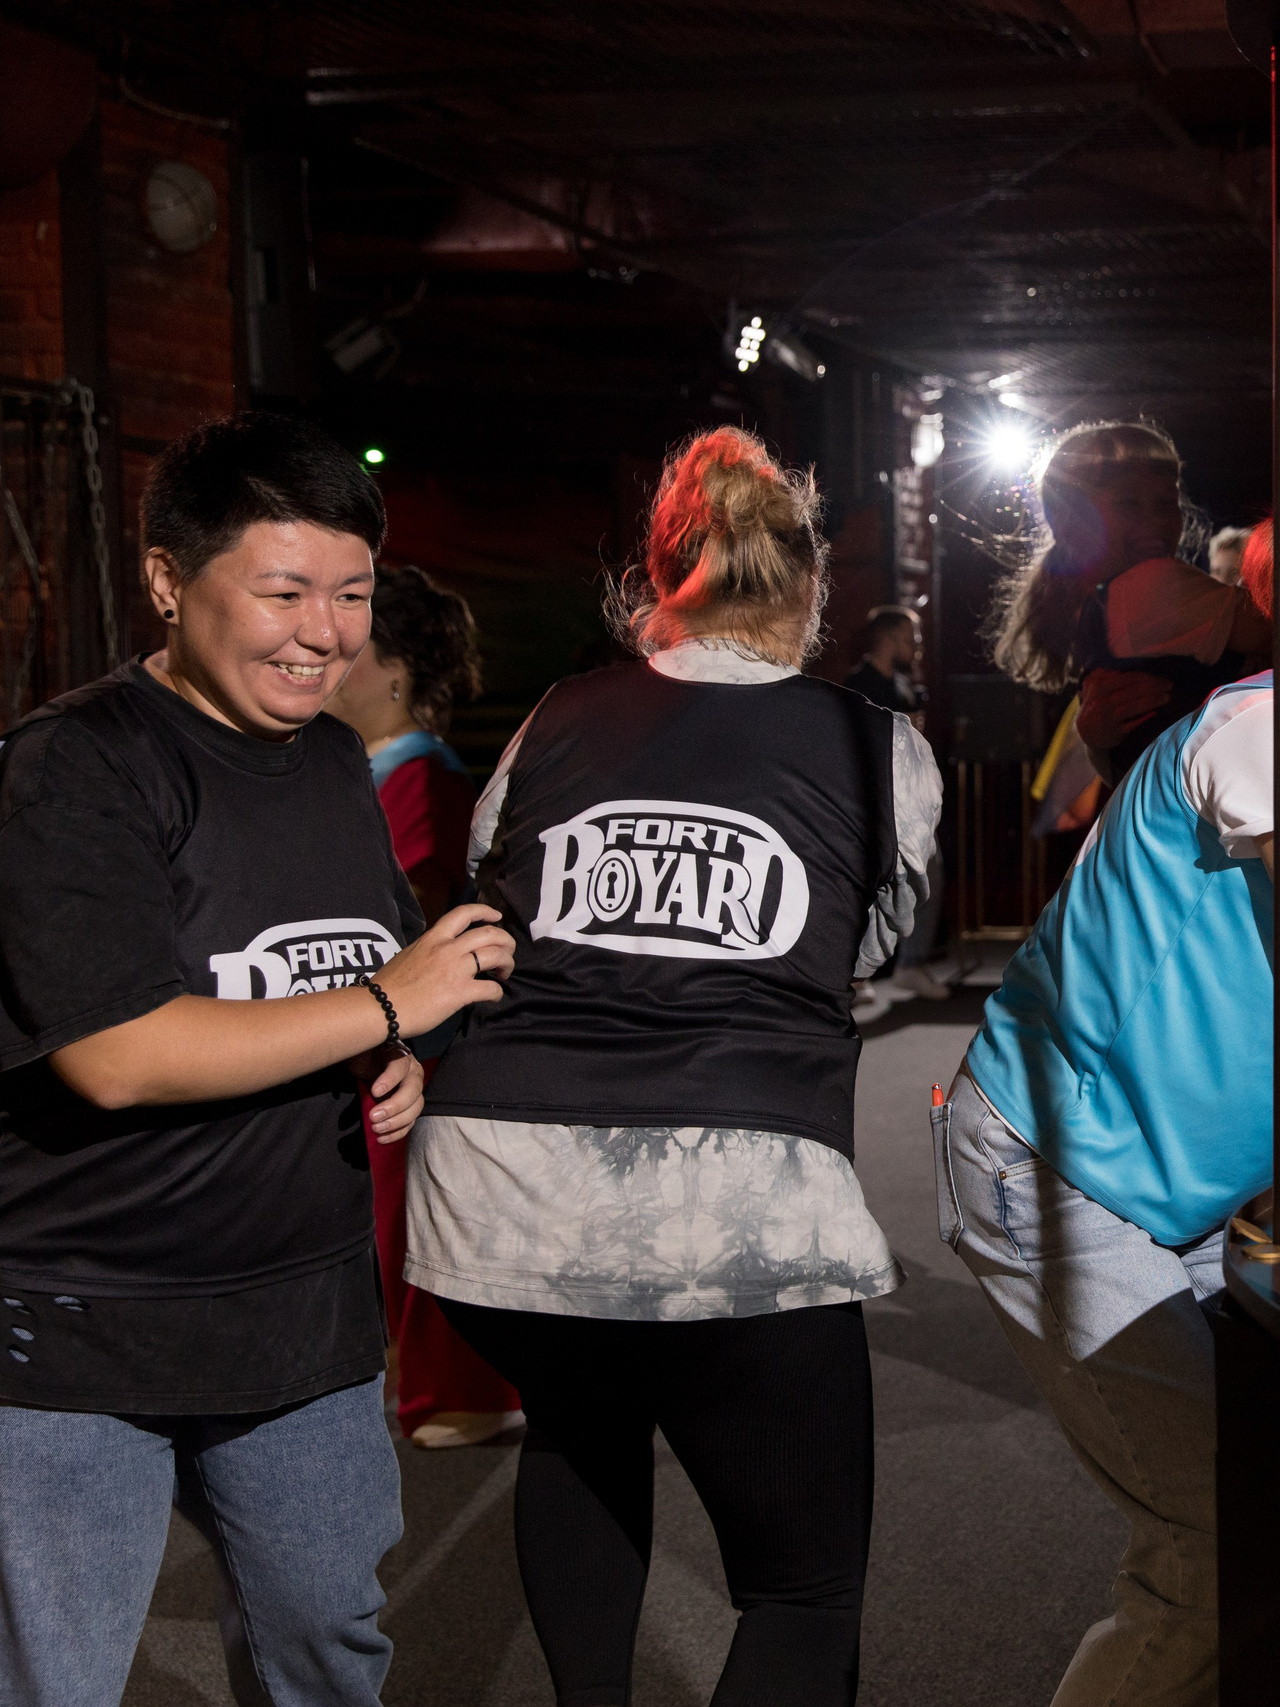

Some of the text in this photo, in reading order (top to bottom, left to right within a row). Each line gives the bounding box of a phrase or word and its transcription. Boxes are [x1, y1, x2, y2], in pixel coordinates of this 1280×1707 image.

[605, 818, 739, 853] FORT
[530, 808, 810, 960] BOYARD
[286, 939, 374, 975] FORT
